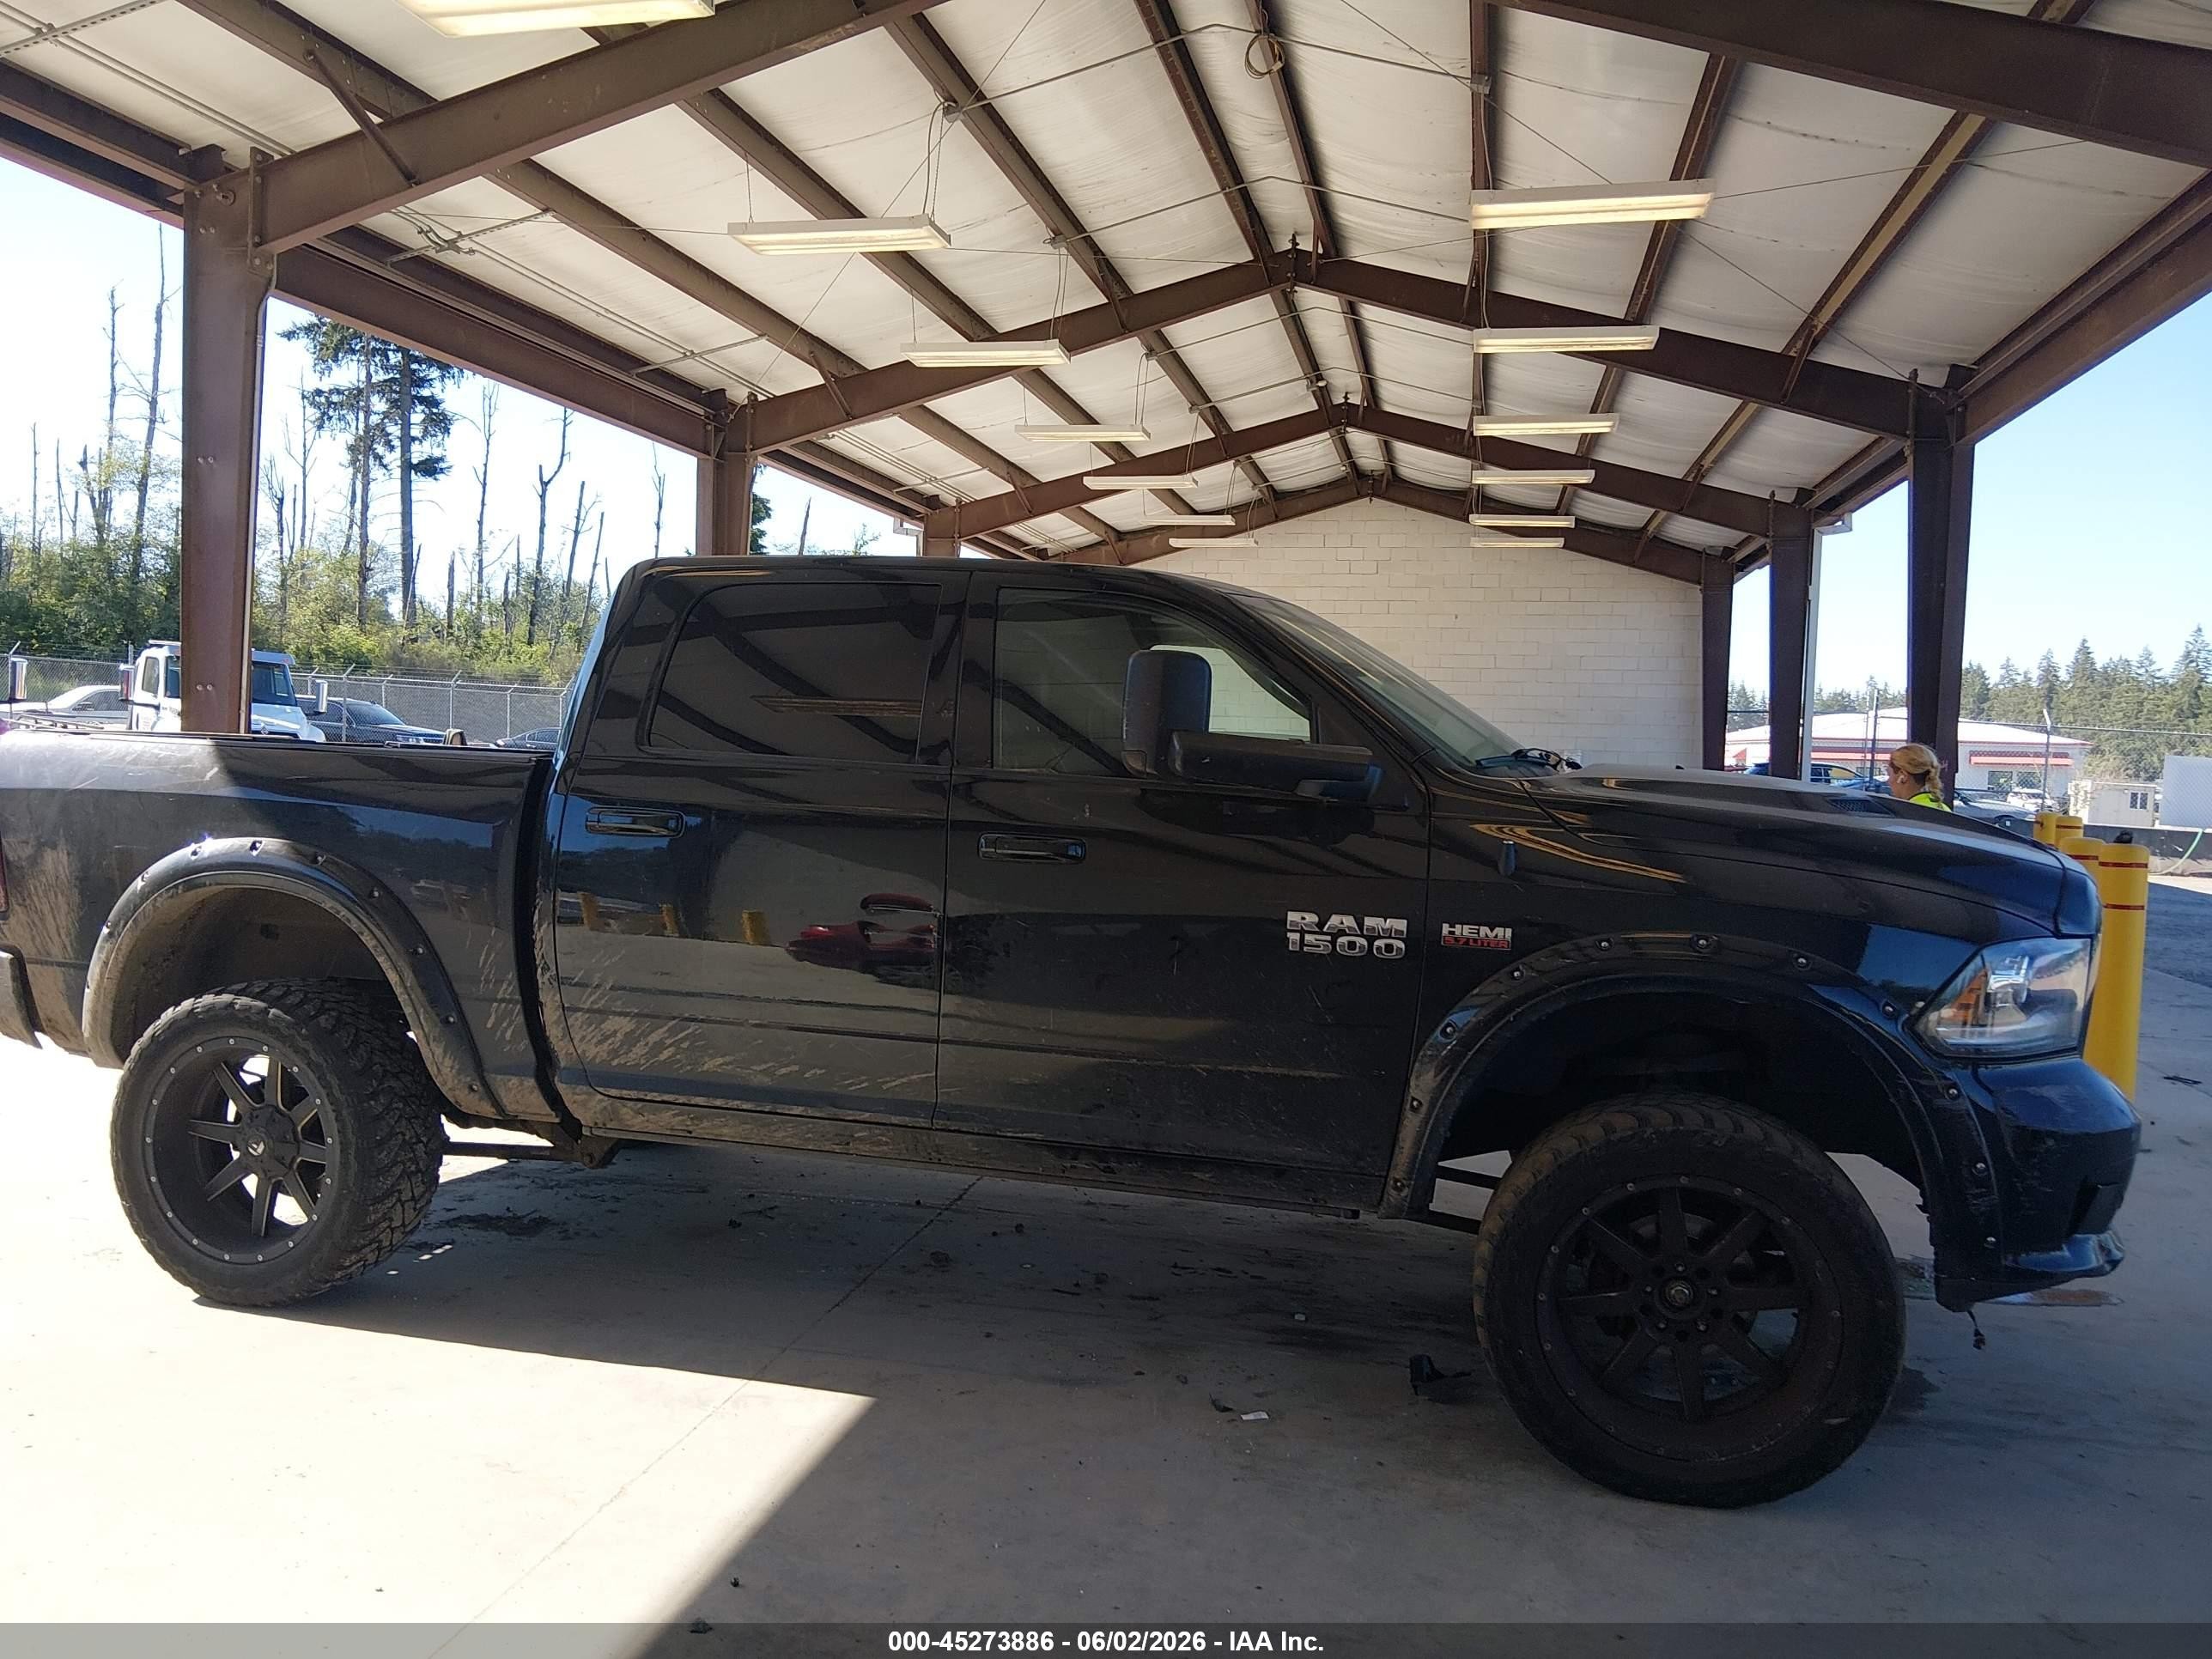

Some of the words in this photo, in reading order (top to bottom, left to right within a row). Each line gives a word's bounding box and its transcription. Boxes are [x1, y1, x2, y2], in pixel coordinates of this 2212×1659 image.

[1286, 911, 1408, 938] RAM
[1442, 922, 1512, 939] HEMI
[1287, 932, 1406, 959] 1500
[1469, 938, 1509, 949] LITER
